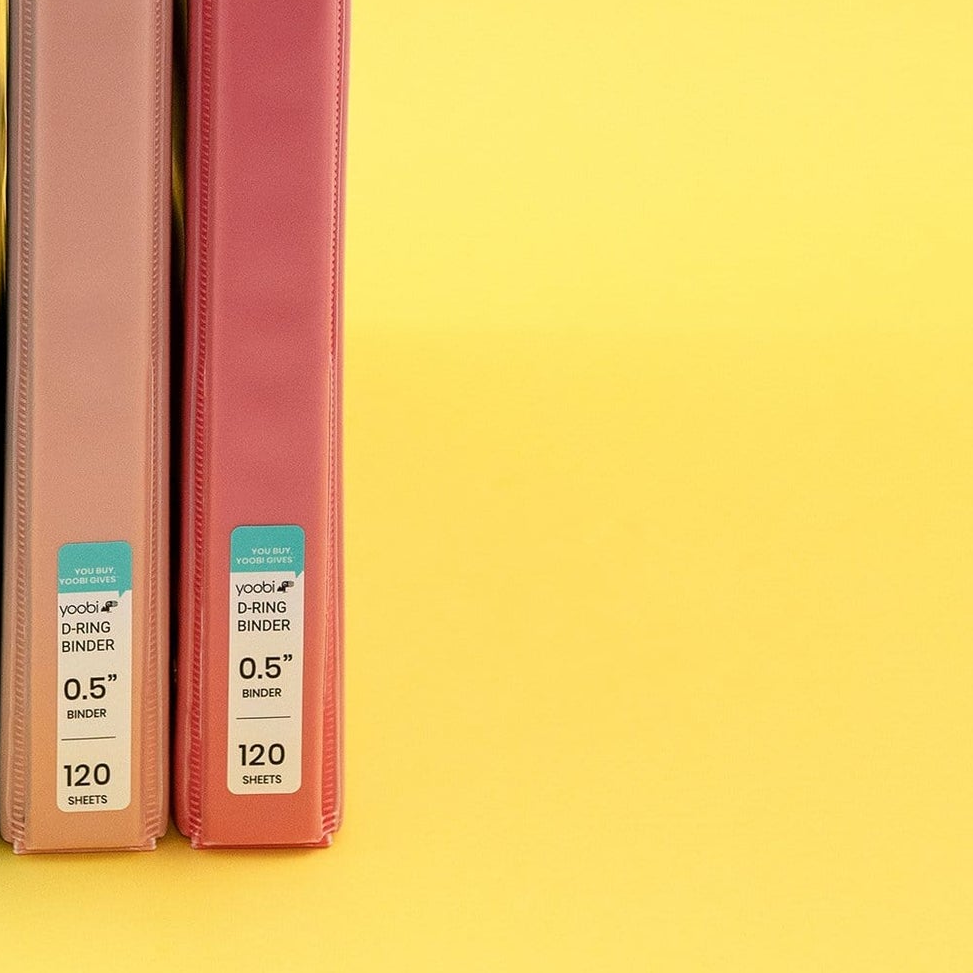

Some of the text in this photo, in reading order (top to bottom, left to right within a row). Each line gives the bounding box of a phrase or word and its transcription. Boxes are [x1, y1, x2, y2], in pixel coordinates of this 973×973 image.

[251, 547, 271, 555] YOU
[235, 556, 293, 565] YOOBI GIVES
[75, 567, 94, 576] YOU
[58, 576, 117, 586] YOOBI GIVES
[235, 580, 275, 597] yoobi
[59, 600, 99, 618] yoobi
[237, 601, 287, 614] D-RING
[61, 621, 111, 635] D-RING
[237, 619, 291, 632] BINDER
[61, 638, 115, 653] BINDER
[242, 688, 282, 698] BINDER
[67, 708, 107, 720] BINDER
[238, 743, 285, 766] 120
[63, 763, 111, 787] 120
[242, 774, 282, 785] SHEETS
[68, 795, 108, 805] SHEETS
